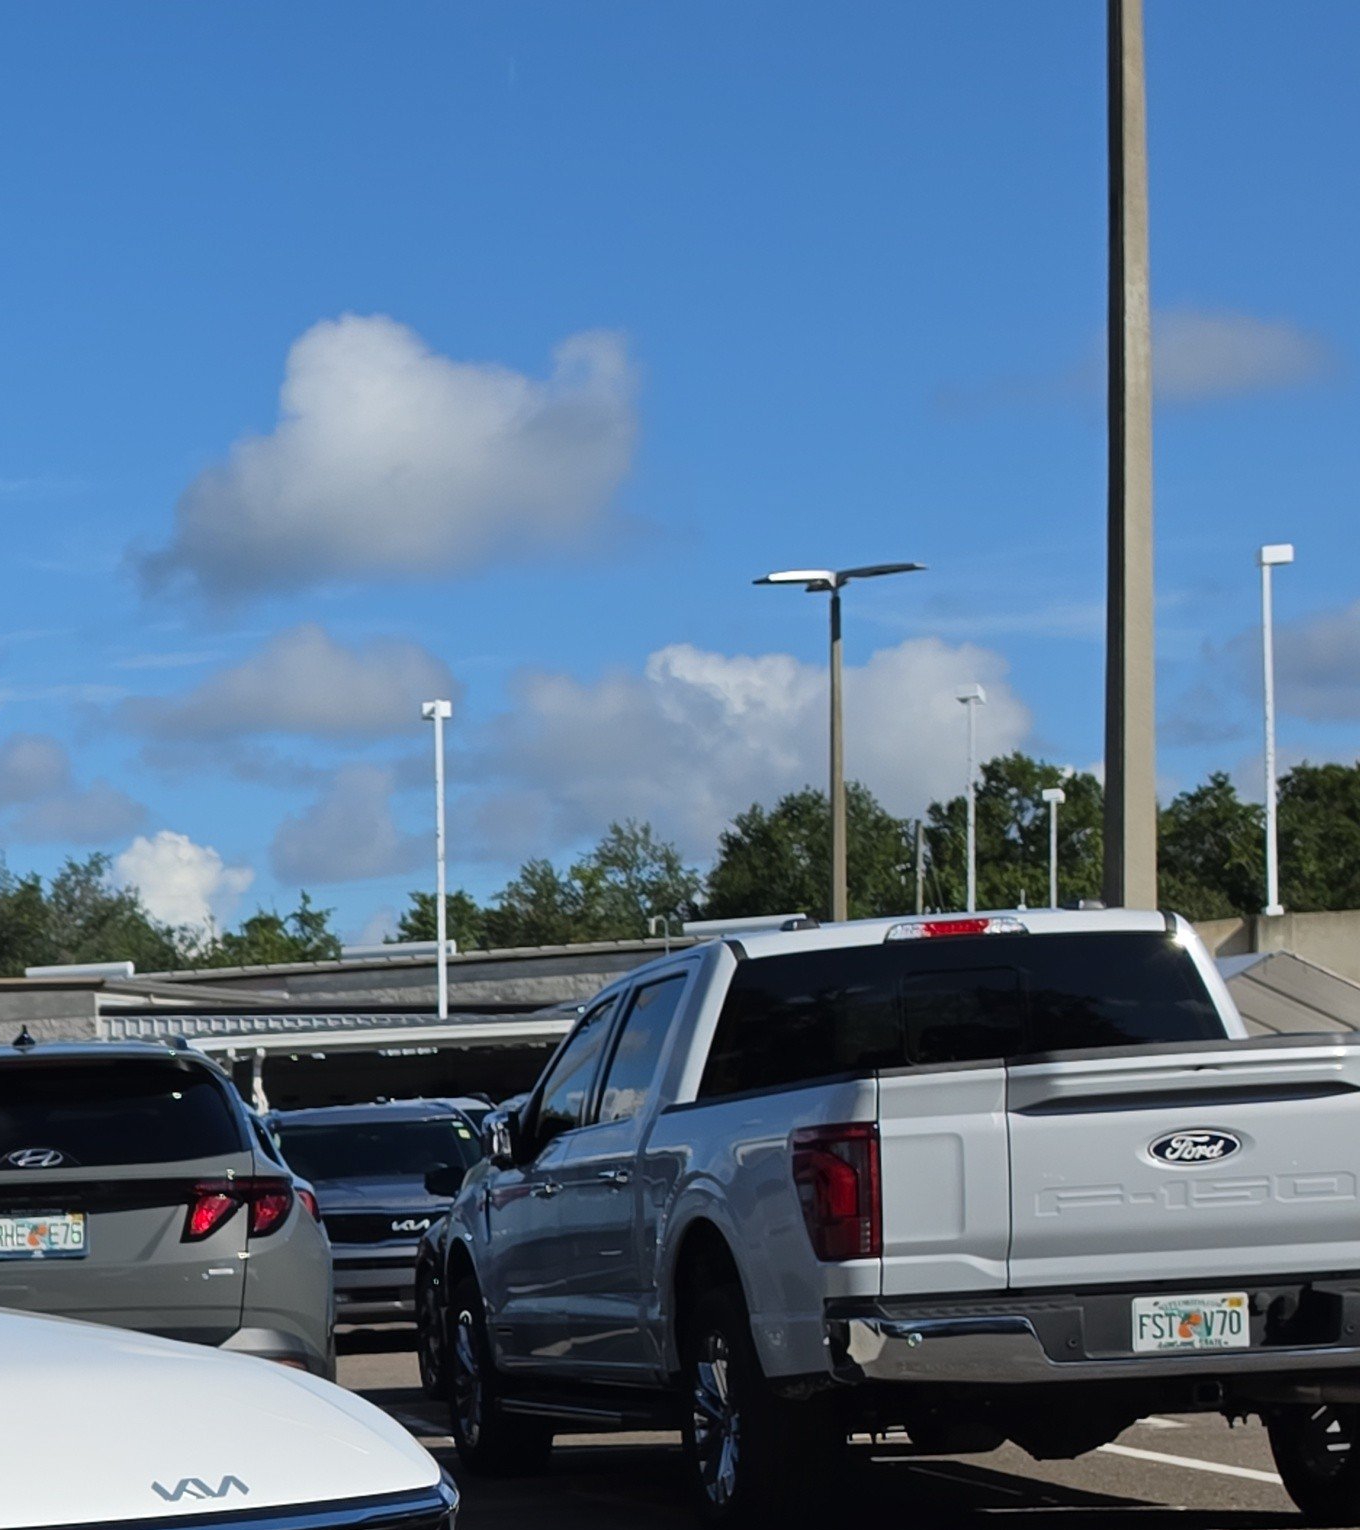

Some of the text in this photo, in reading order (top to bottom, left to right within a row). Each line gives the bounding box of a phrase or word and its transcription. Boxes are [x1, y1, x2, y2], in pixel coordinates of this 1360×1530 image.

[1165, 1135, 1225, 1161] Ford
[1035, 1170, 1357, 1217] F-150
[48, 1223, 82, 1245] E76
[1138, 1309, 1242, 1340] FST V70
[151, 1475, 250, 1502] KIA
